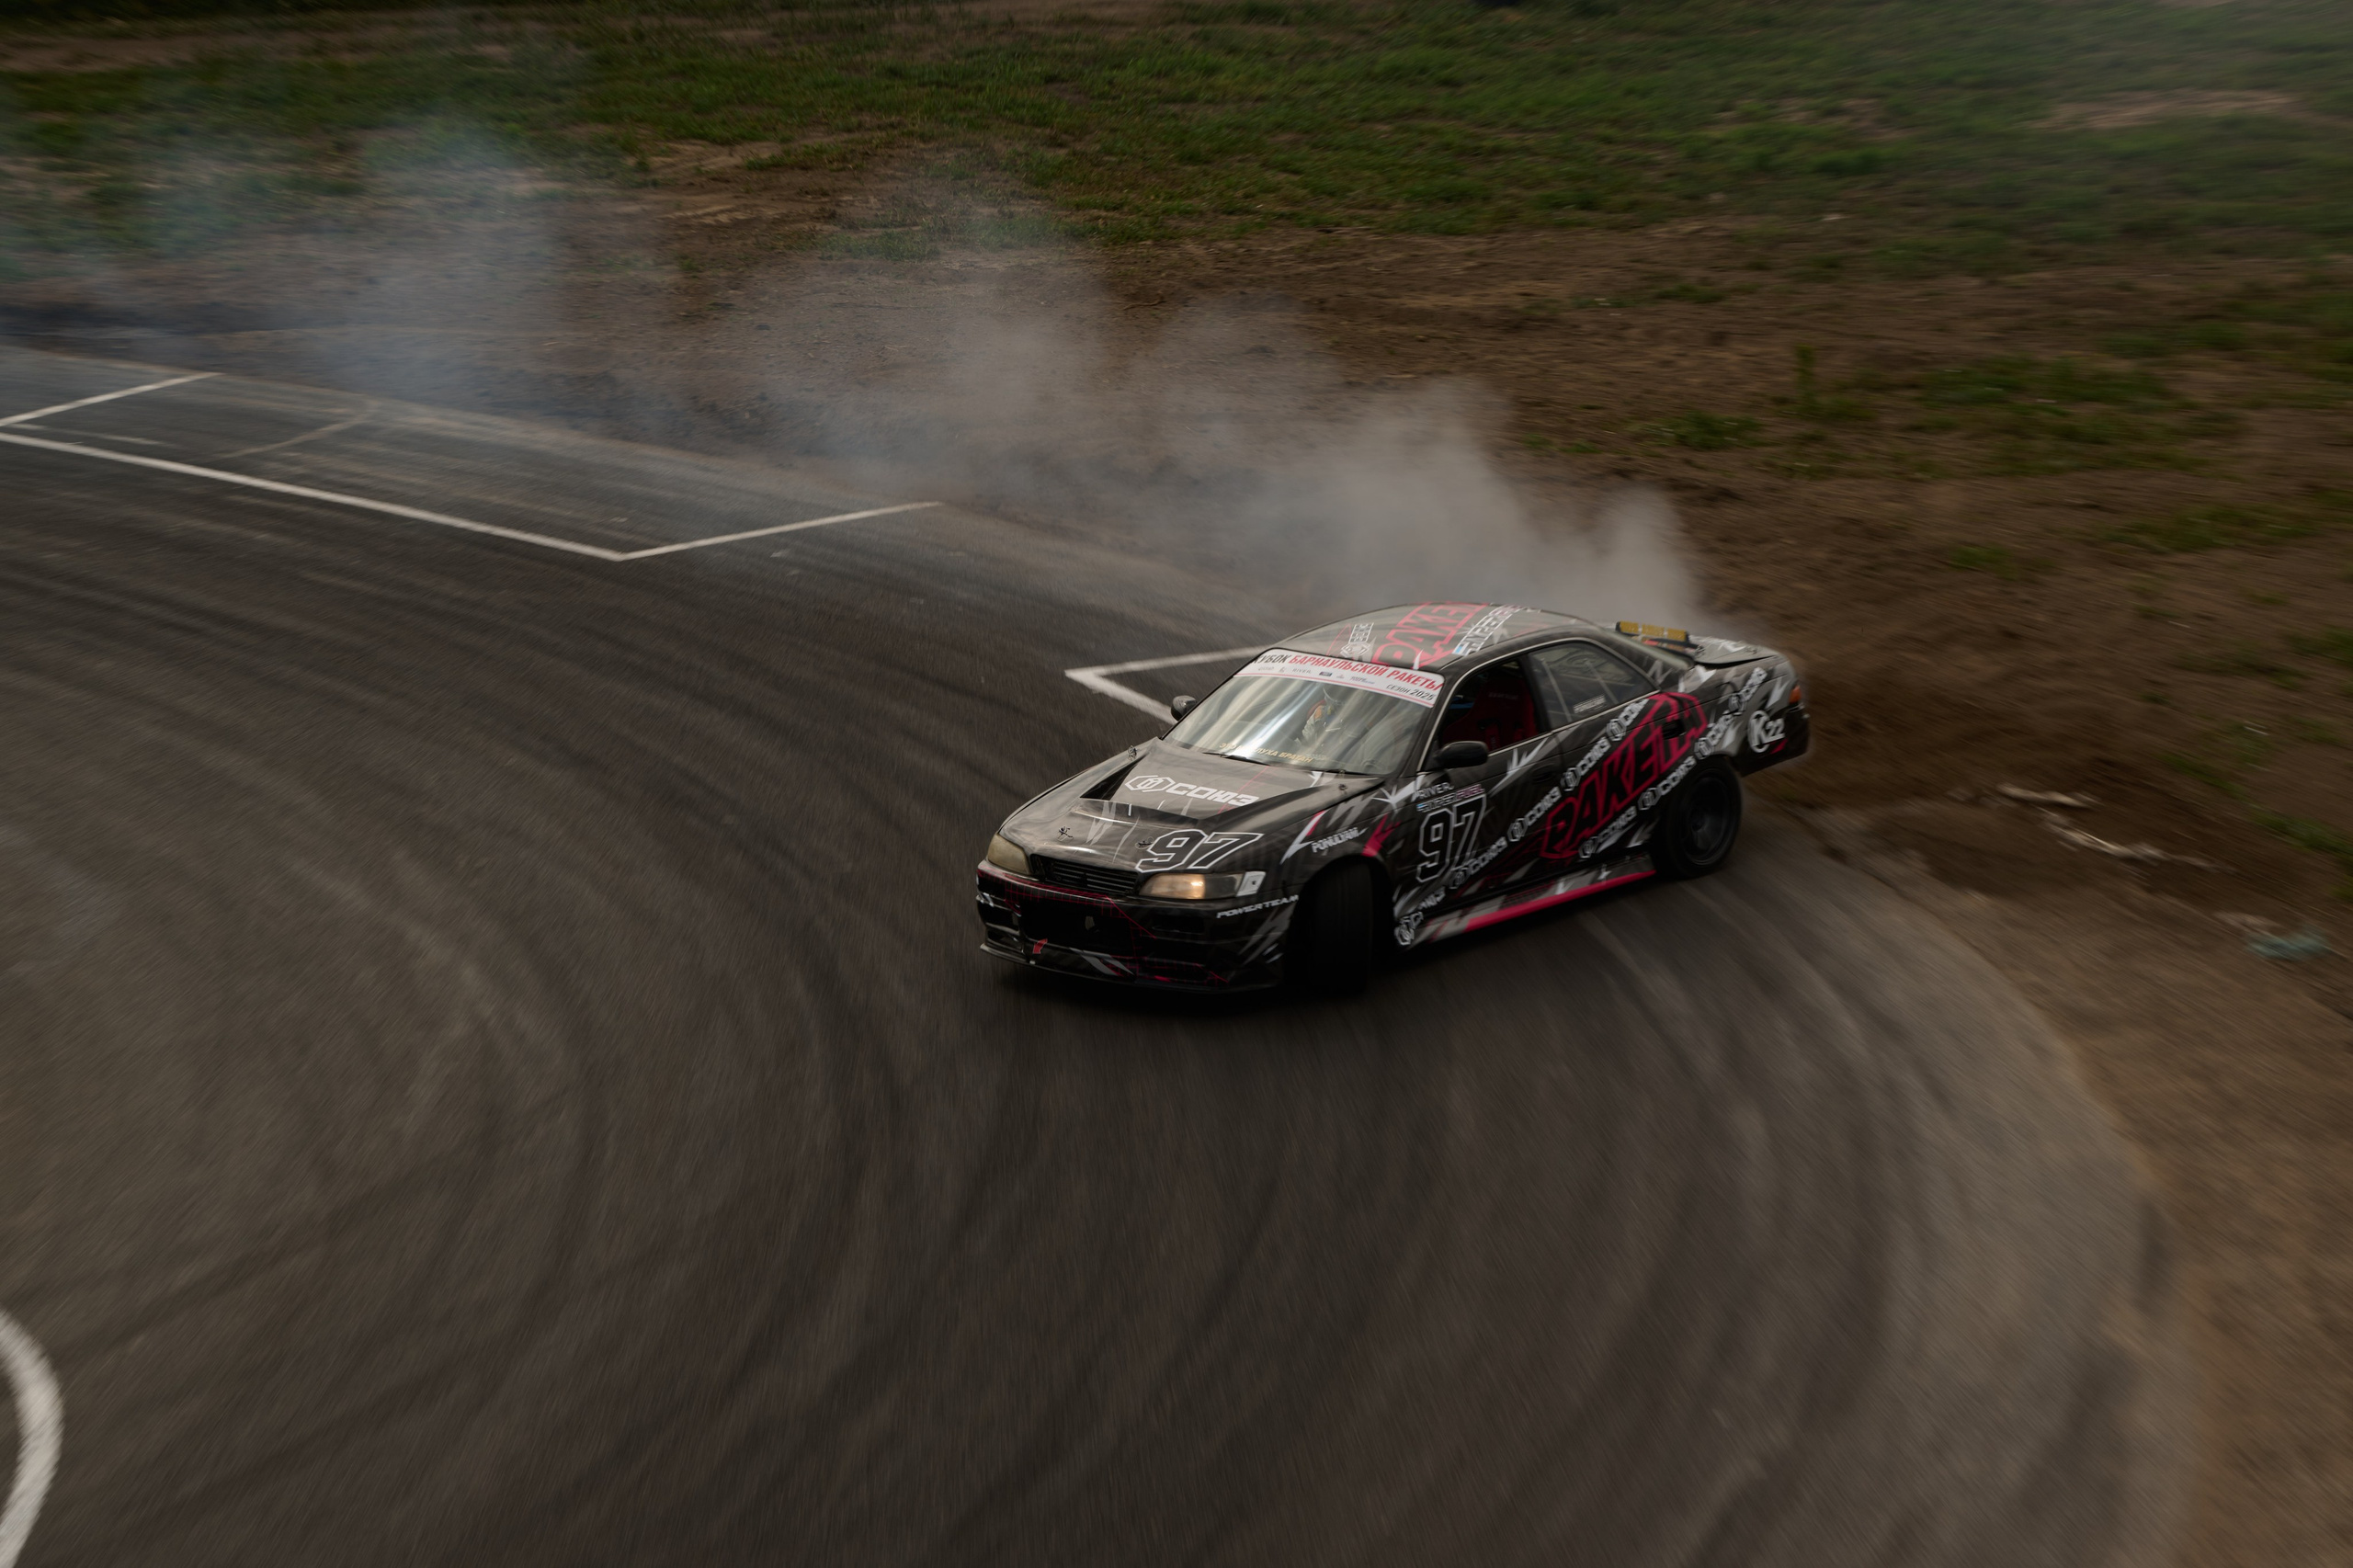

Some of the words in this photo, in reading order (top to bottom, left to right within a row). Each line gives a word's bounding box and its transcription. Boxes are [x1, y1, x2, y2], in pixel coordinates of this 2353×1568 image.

[1289, 655, 1390, 676] БАРНАУЛЬСКОЙ
[1386, 669, 1444, 691] РАКЕТЫ
[1386, 684, 1411, 694] СЕЗОН
[1411, 688, 1436, 701] 2025
[1279, 751, 1314, 763] БРАТАН
[1417, 782, 1454, 800] RIVER
[1134, 828, 1265, 873] 97
[1415, 793, 1486, 882] 97
